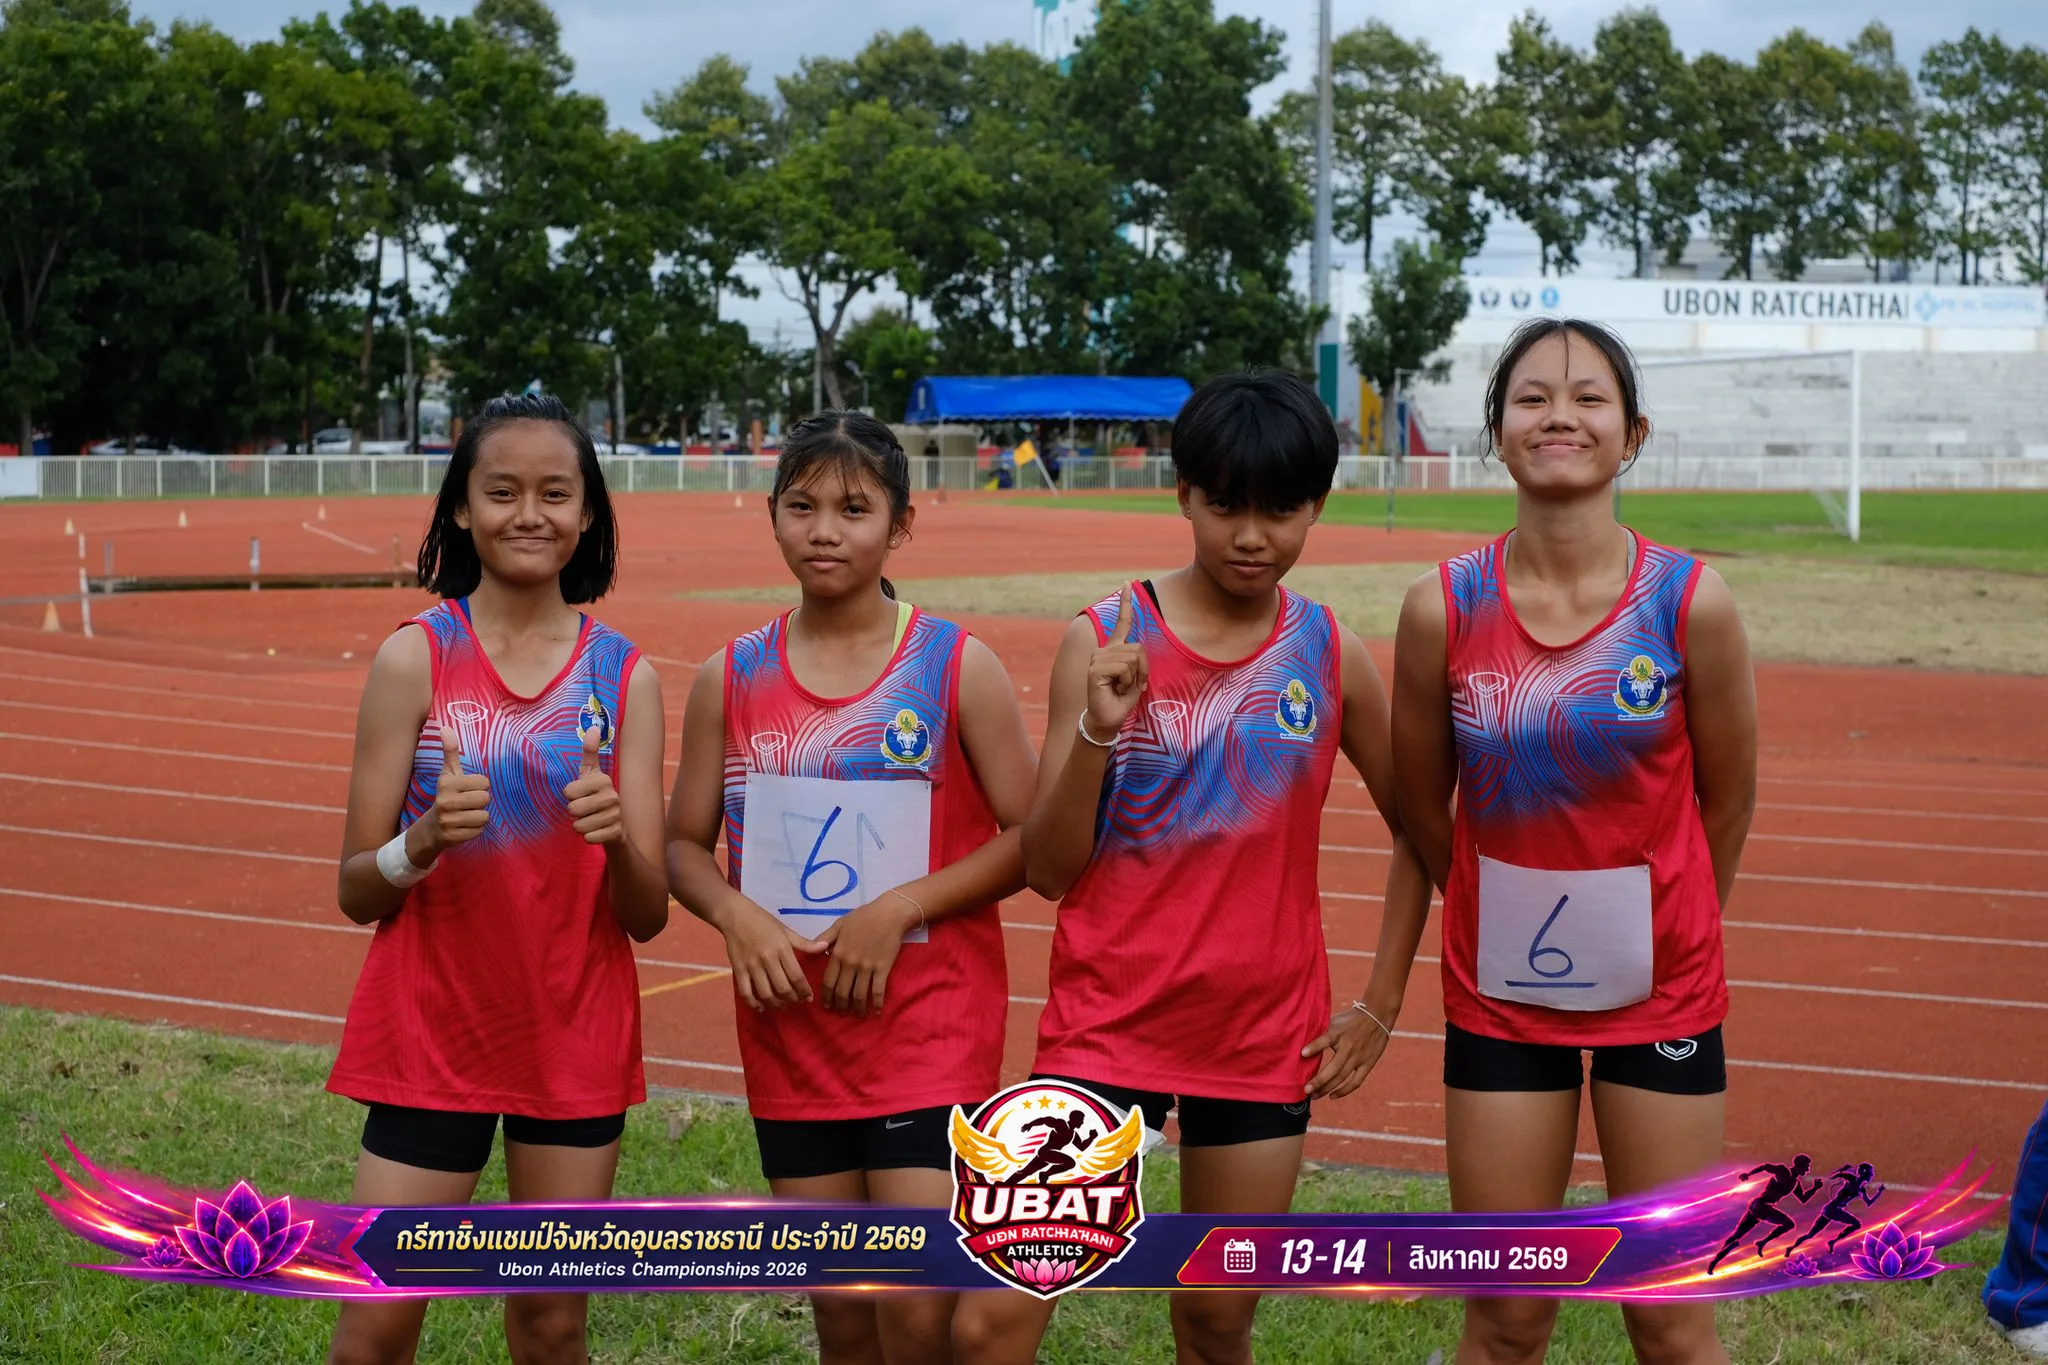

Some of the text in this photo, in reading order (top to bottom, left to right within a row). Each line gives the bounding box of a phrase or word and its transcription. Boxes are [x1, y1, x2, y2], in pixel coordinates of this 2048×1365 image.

[1664, 288, 1740, 316] UBON
[799, 805, 859, 903] 6
[1528, 893, 1574, 977] 6
